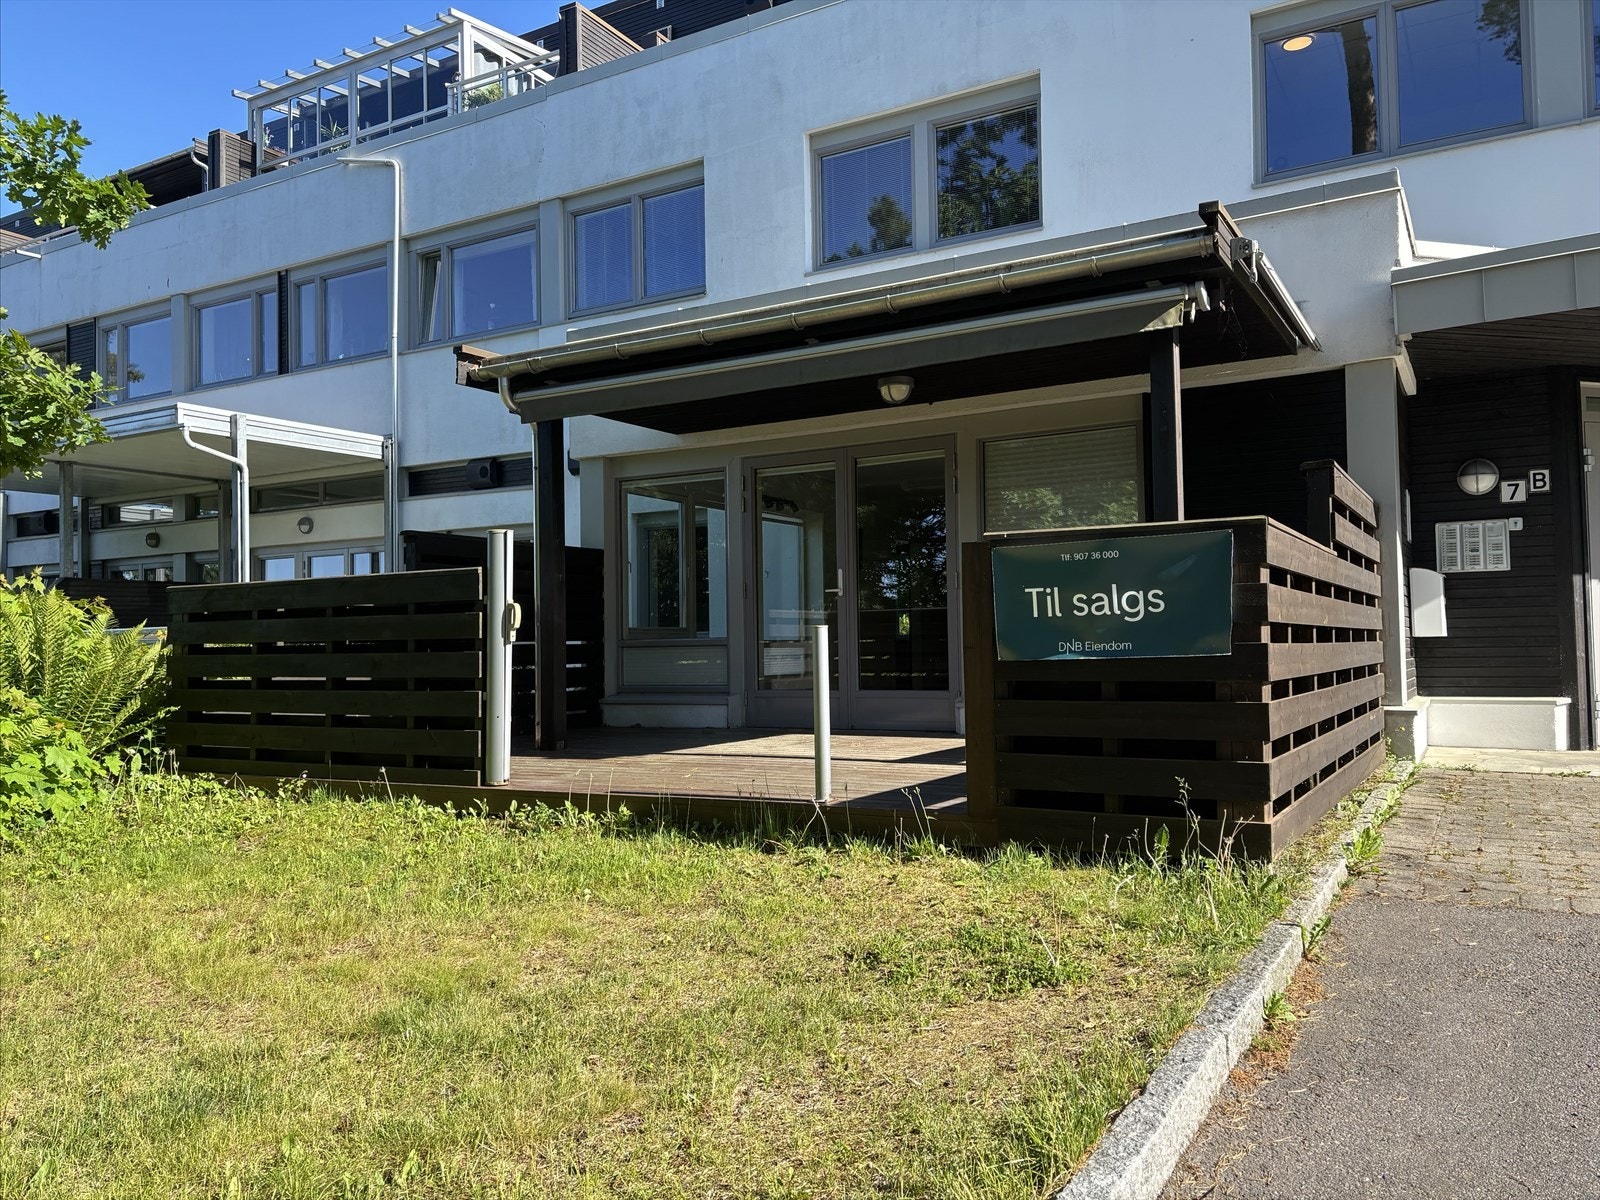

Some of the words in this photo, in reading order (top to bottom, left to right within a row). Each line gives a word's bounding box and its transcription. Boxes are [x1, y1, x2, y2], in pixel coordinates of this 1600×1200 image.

[1507, 483, 1520, 500] 7
[1533, 472, 1547, 489] B
[1060, 553, 1073, 562] Tlf:
[1073, 552, 1089, 561] 907
[1091, 551, 1101, 560] 36
[1102, 550, 1119, 559] 000
[1024, 586, 1062, 617] Til
[1072, 584, 1165, 622] salgs
[1058, 638, 1083, 655] DNB
[1085, 640, 1132, 651] Eiendom
